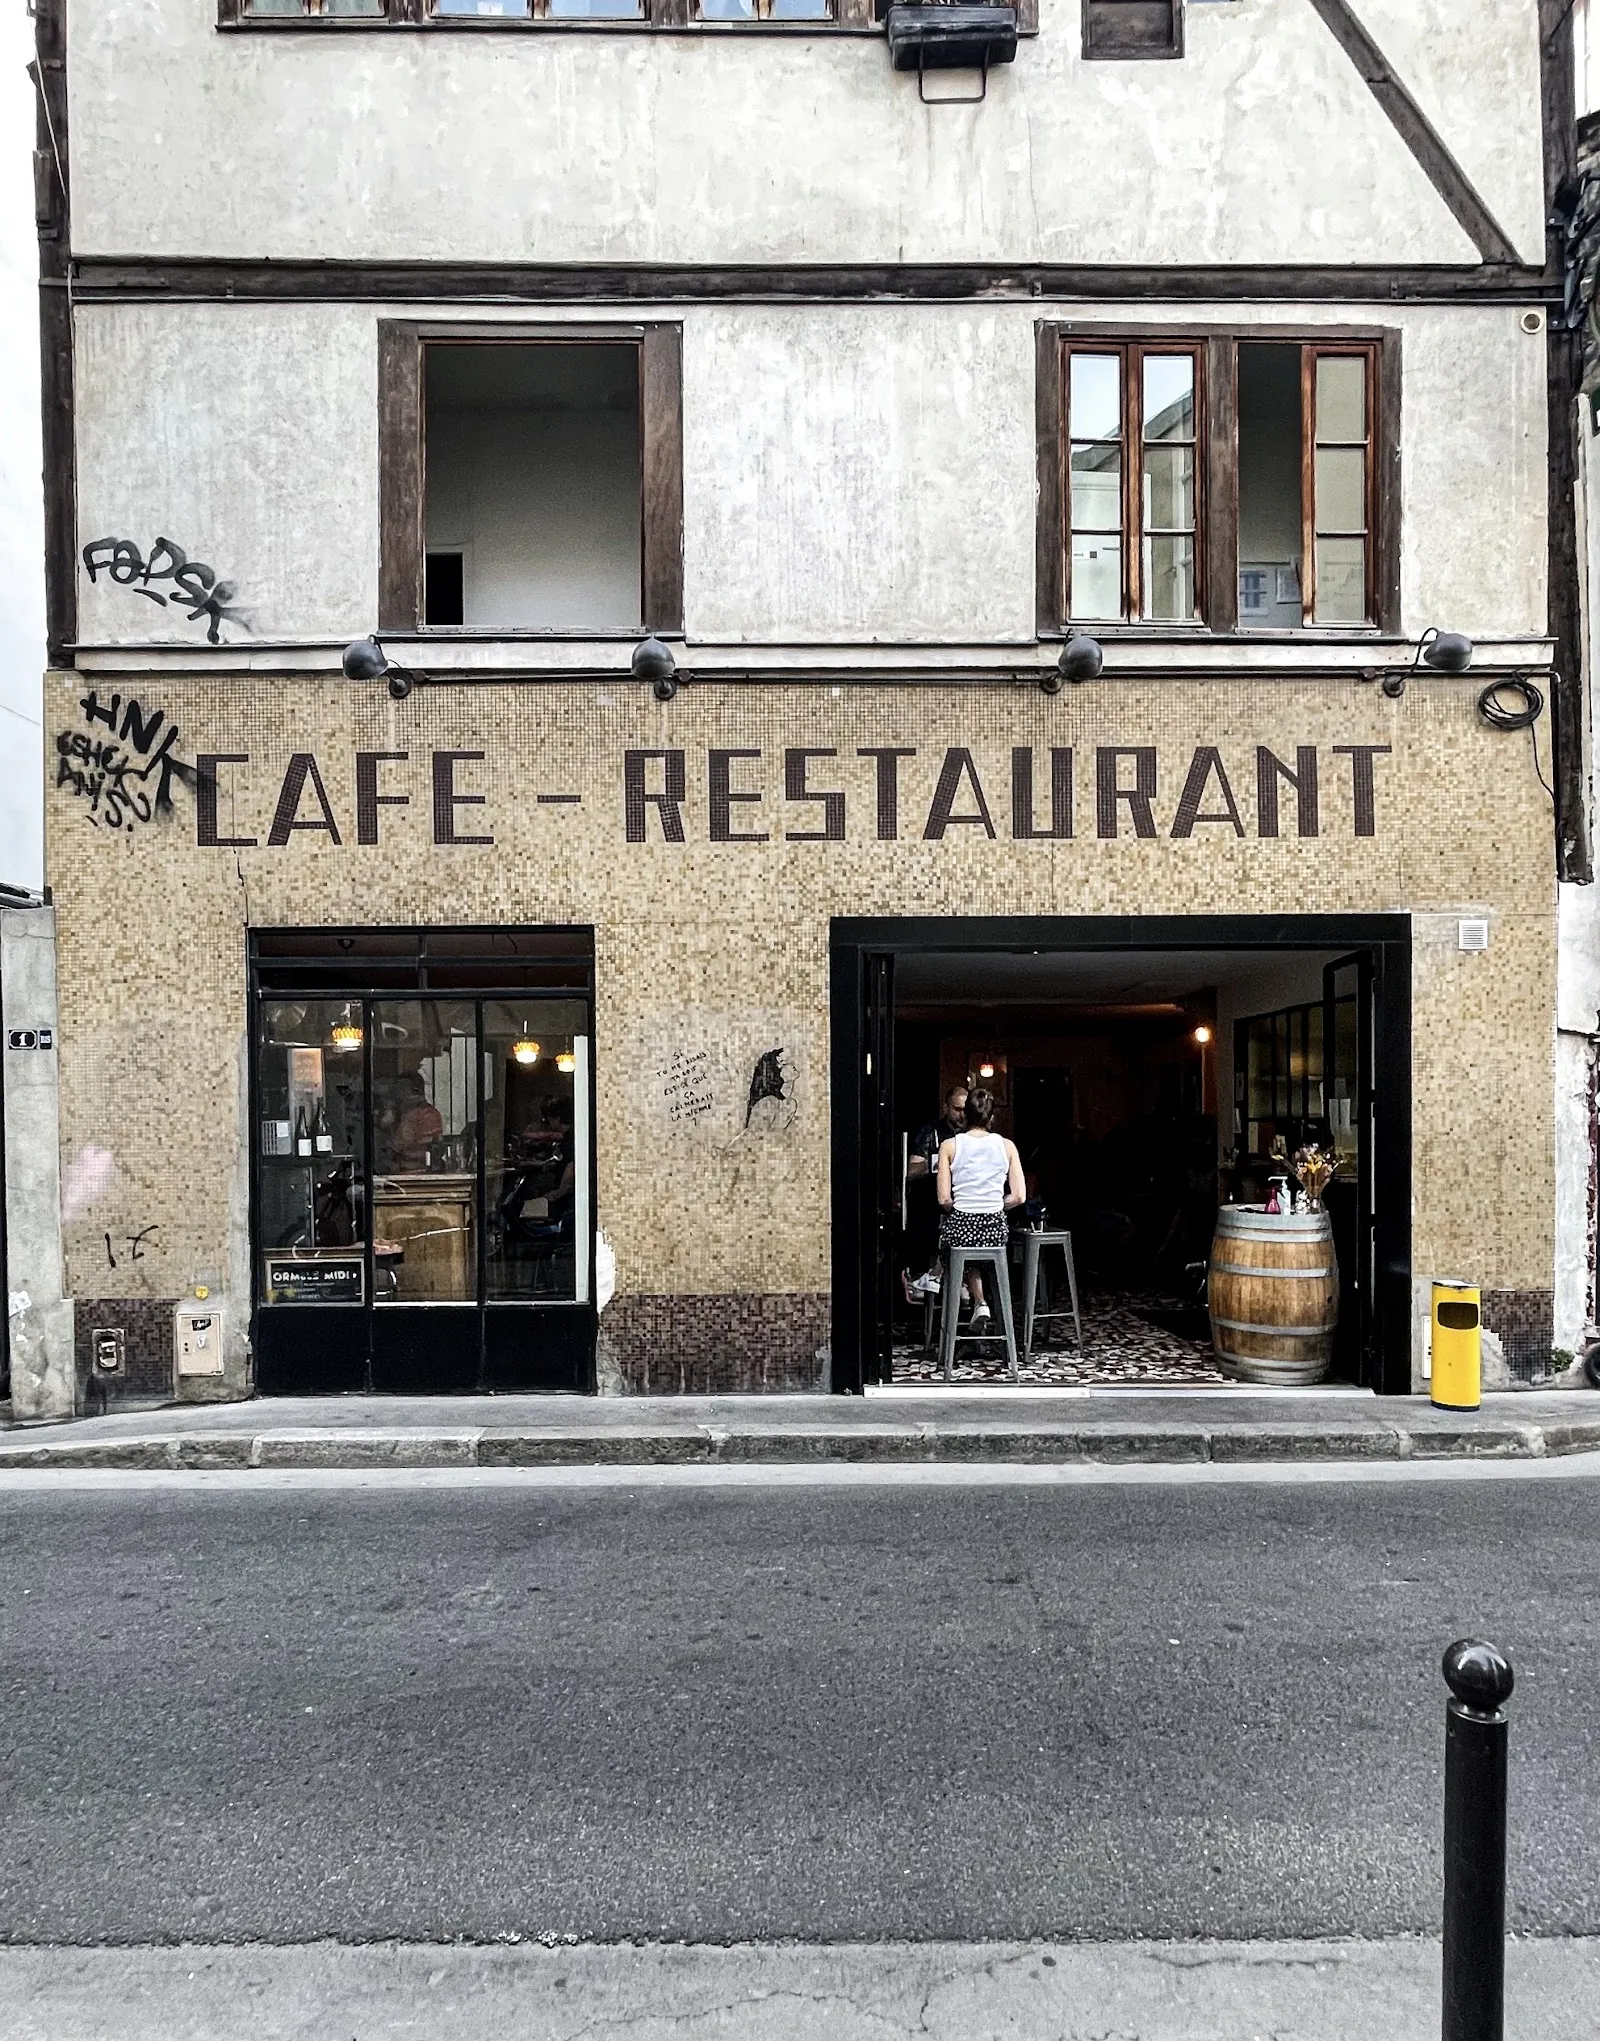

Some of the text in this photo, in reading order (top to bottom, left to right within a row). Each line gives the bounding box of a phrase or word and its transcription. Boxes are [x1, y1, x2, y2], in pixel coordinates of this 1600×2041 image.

[196, 751, 495, 846] CAFE
[624, 745, 1392, 843] RESTAURANT
[19, 1032, 27, 1046] 1
[692, 1073, 707, 1084] QUE
[671, 1113, 682, 1122] LA
